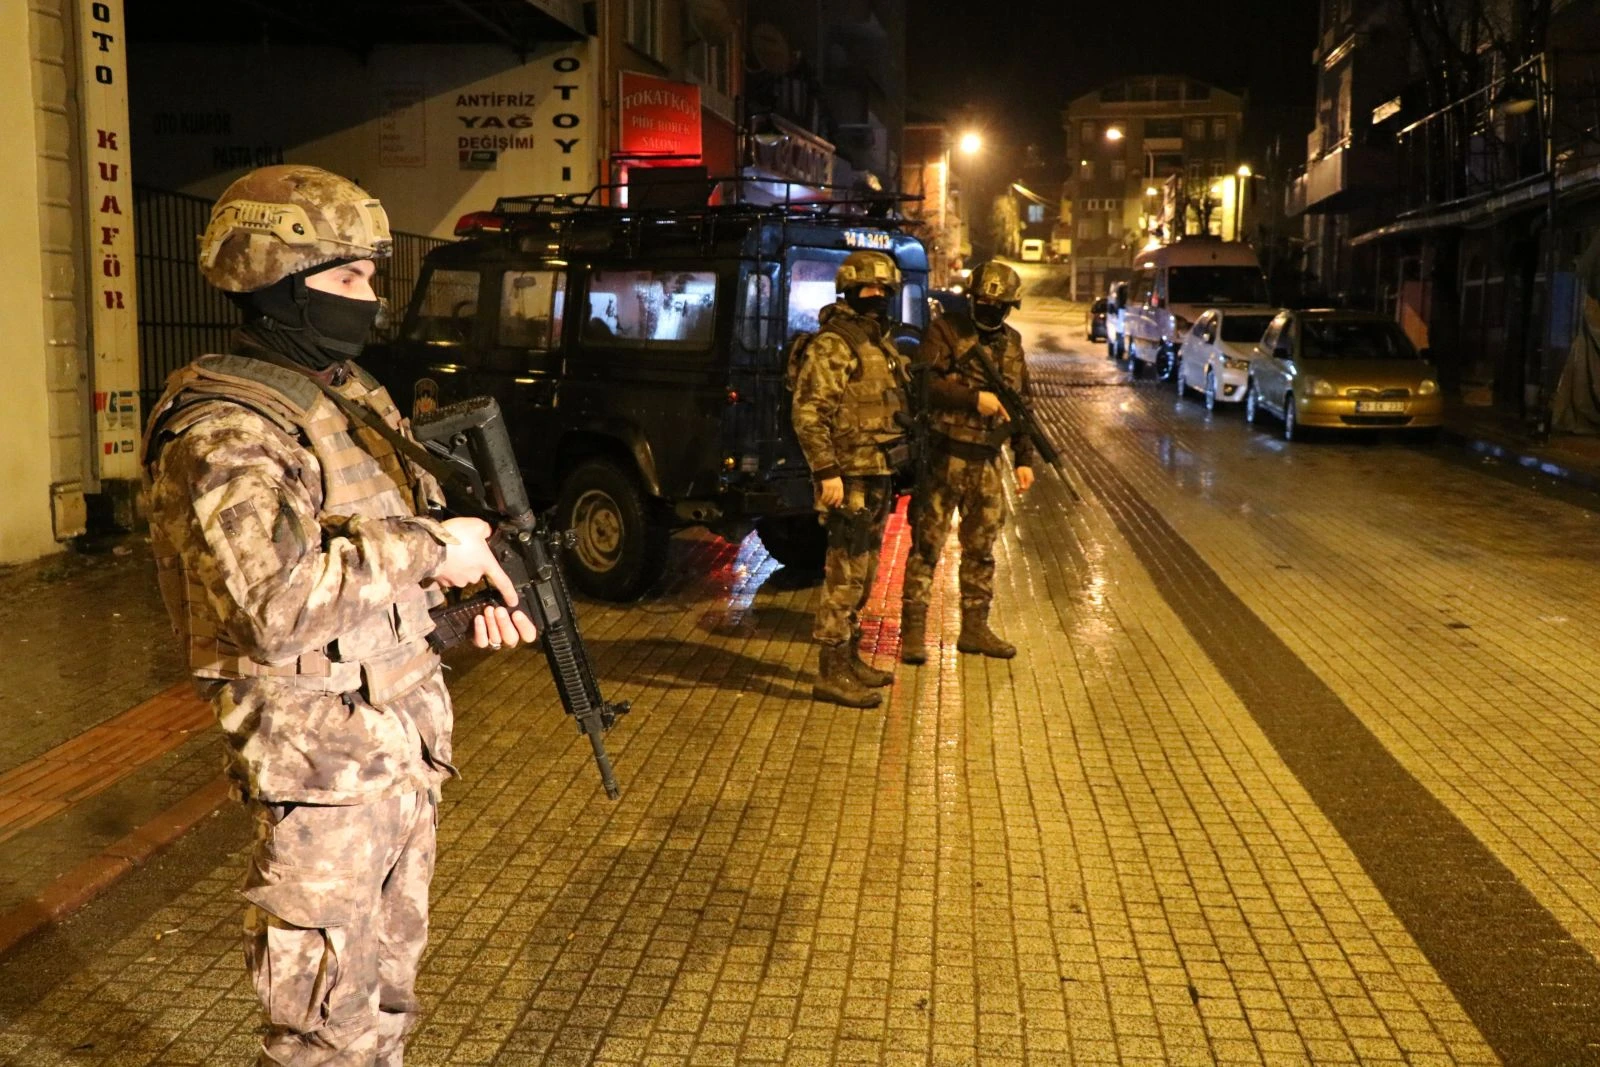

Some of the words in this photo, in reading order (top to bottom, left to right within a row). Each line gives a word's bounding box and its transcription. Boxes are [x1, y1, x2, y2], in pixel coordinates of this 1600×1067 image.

[92, 2, 114, 85] OTO
[456, 91, 536, 107] ANTİFRİZ
[458, 113, 534, 128] YAĞ
[458, 134, 534, 151] DEĞİŞİMİ
[97, 129, 125, 310] KUAFÖR
